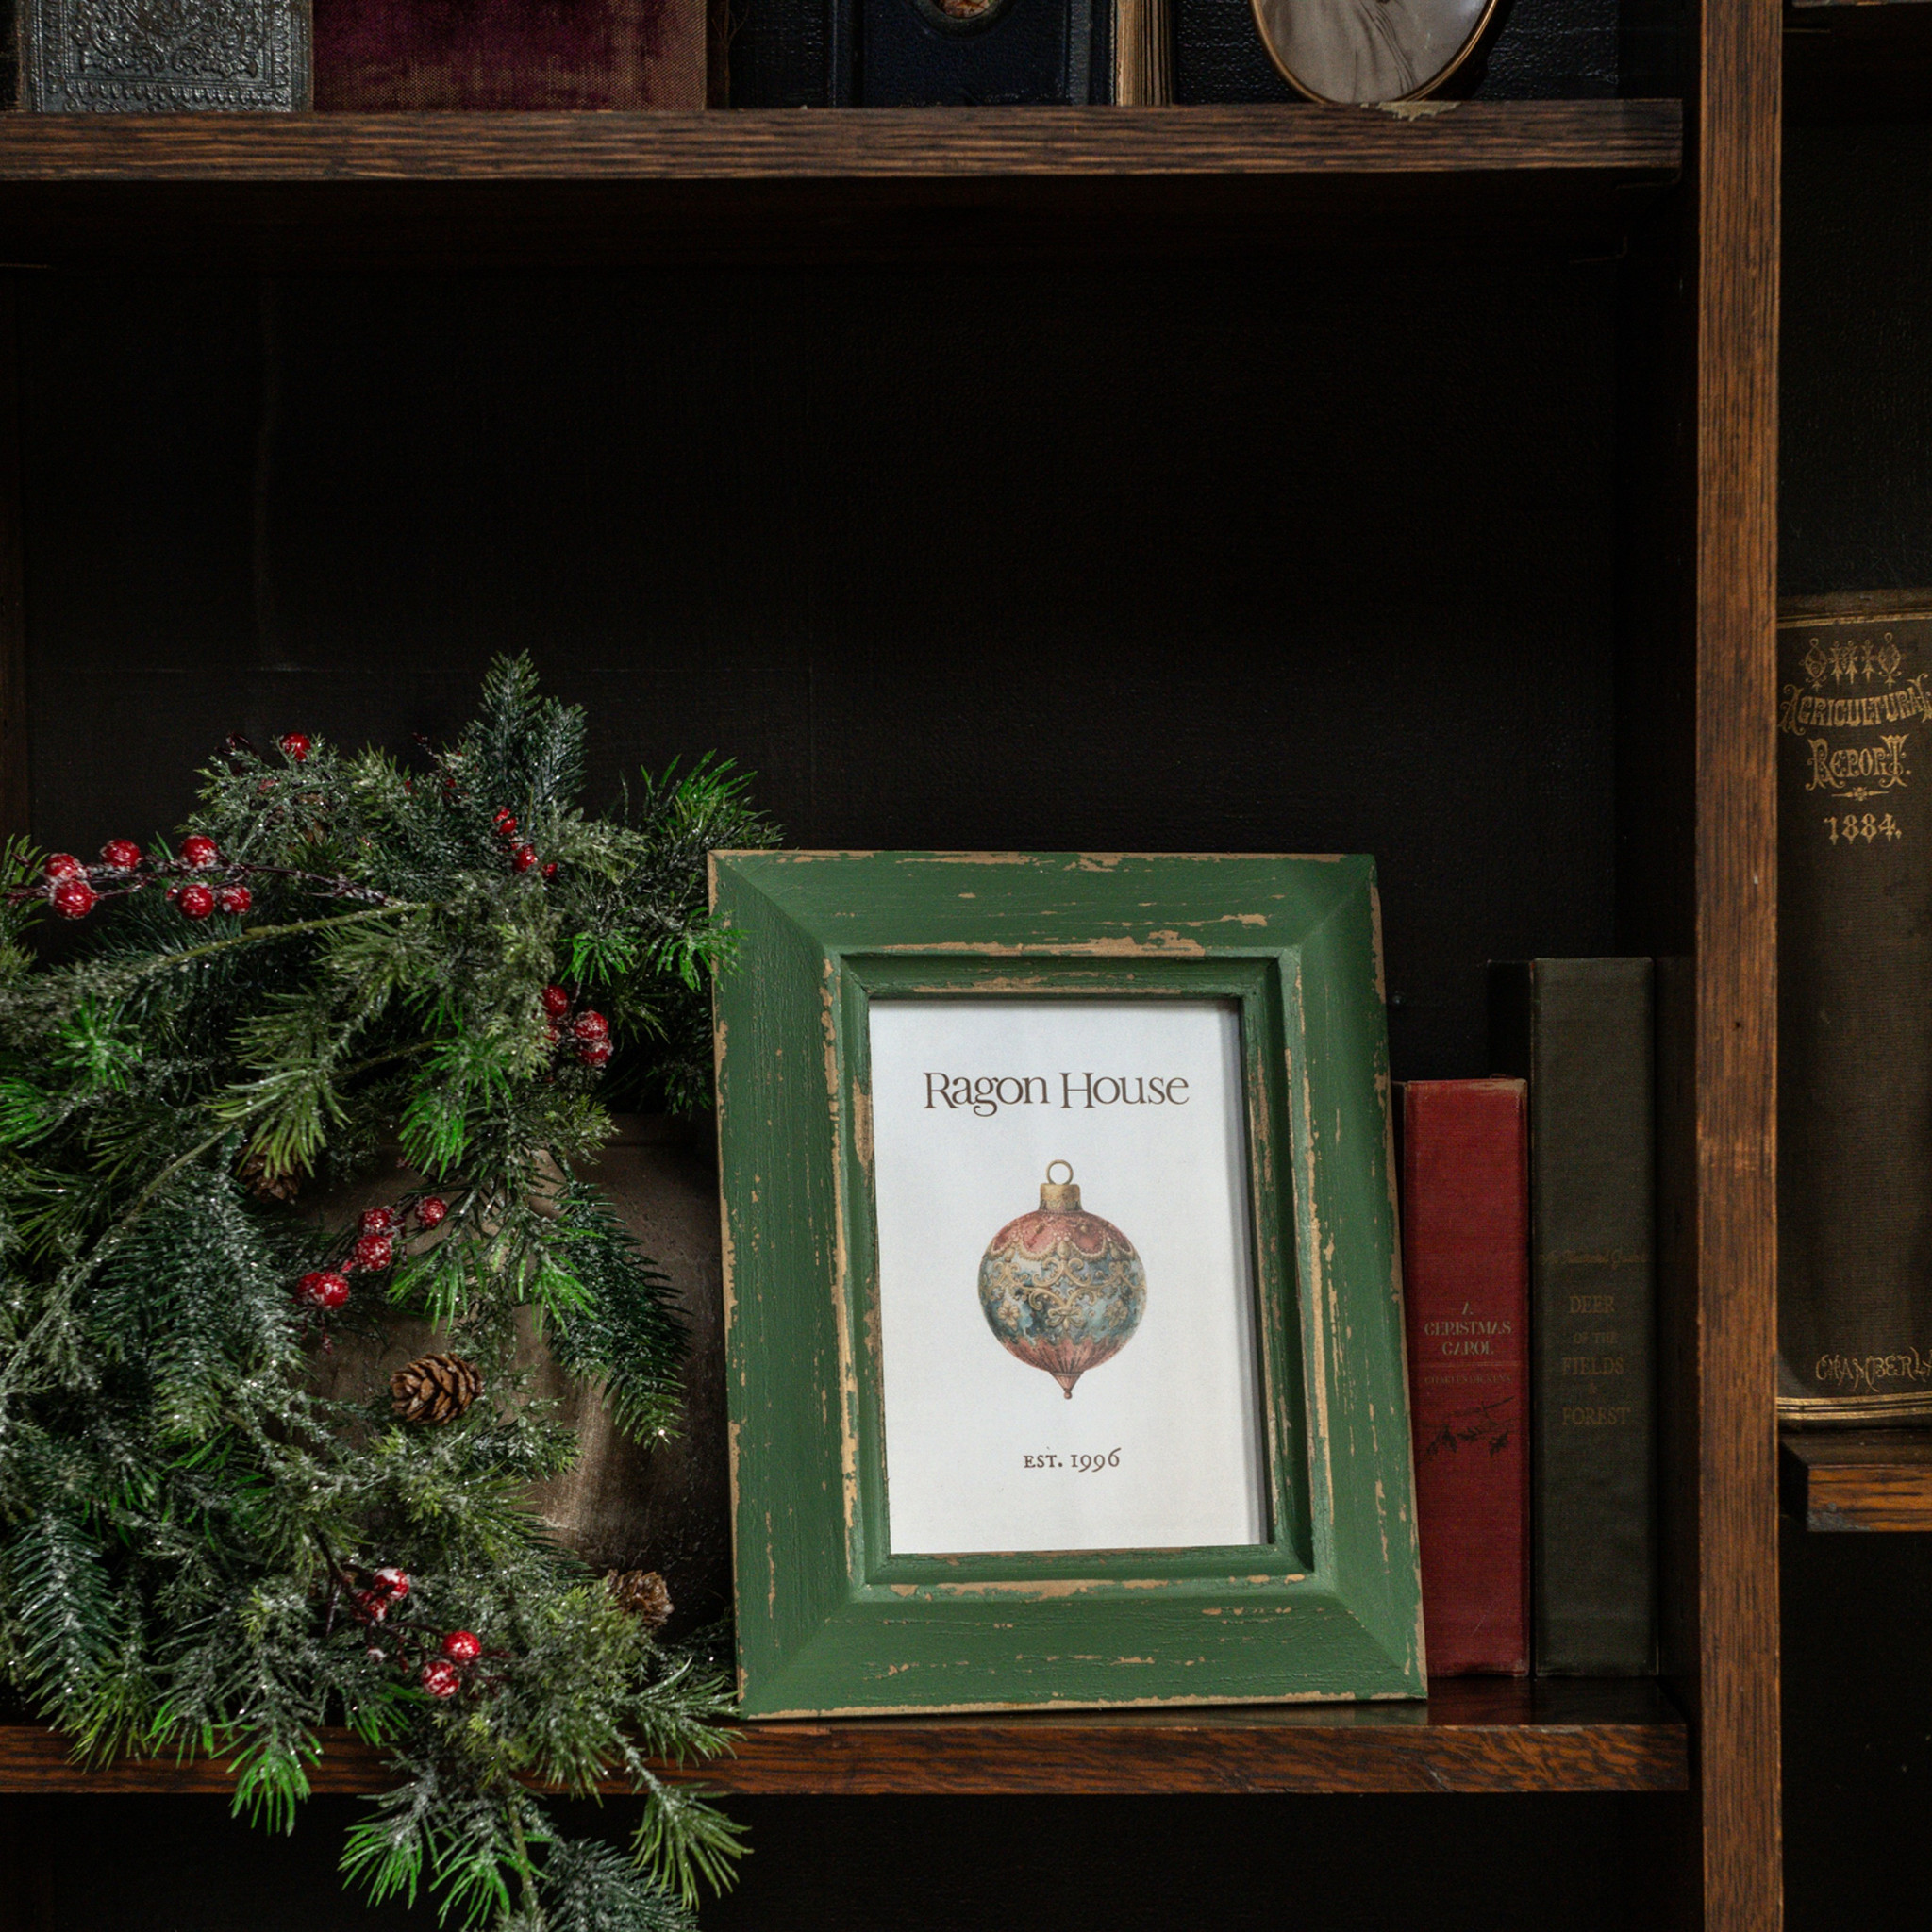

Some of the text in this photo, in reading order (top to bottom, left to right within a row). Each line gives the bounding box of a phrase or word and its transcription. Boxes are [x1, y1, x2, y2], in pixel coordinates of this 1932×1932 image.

[923, 1072, 1190, 1117] Ragon House
[1569, 1294, 1615, 1314] DEER
[1424, 1320, 1512, 1336] CHRISTMAS
[1441, 1341, 1495, 1357] CAROL
[1561, 1356, 1625, 1377] FIELDS
[1561, 1405, 1633, 1426] FOREST
[1023, 1447, 1122, 1473] EST. 1996
